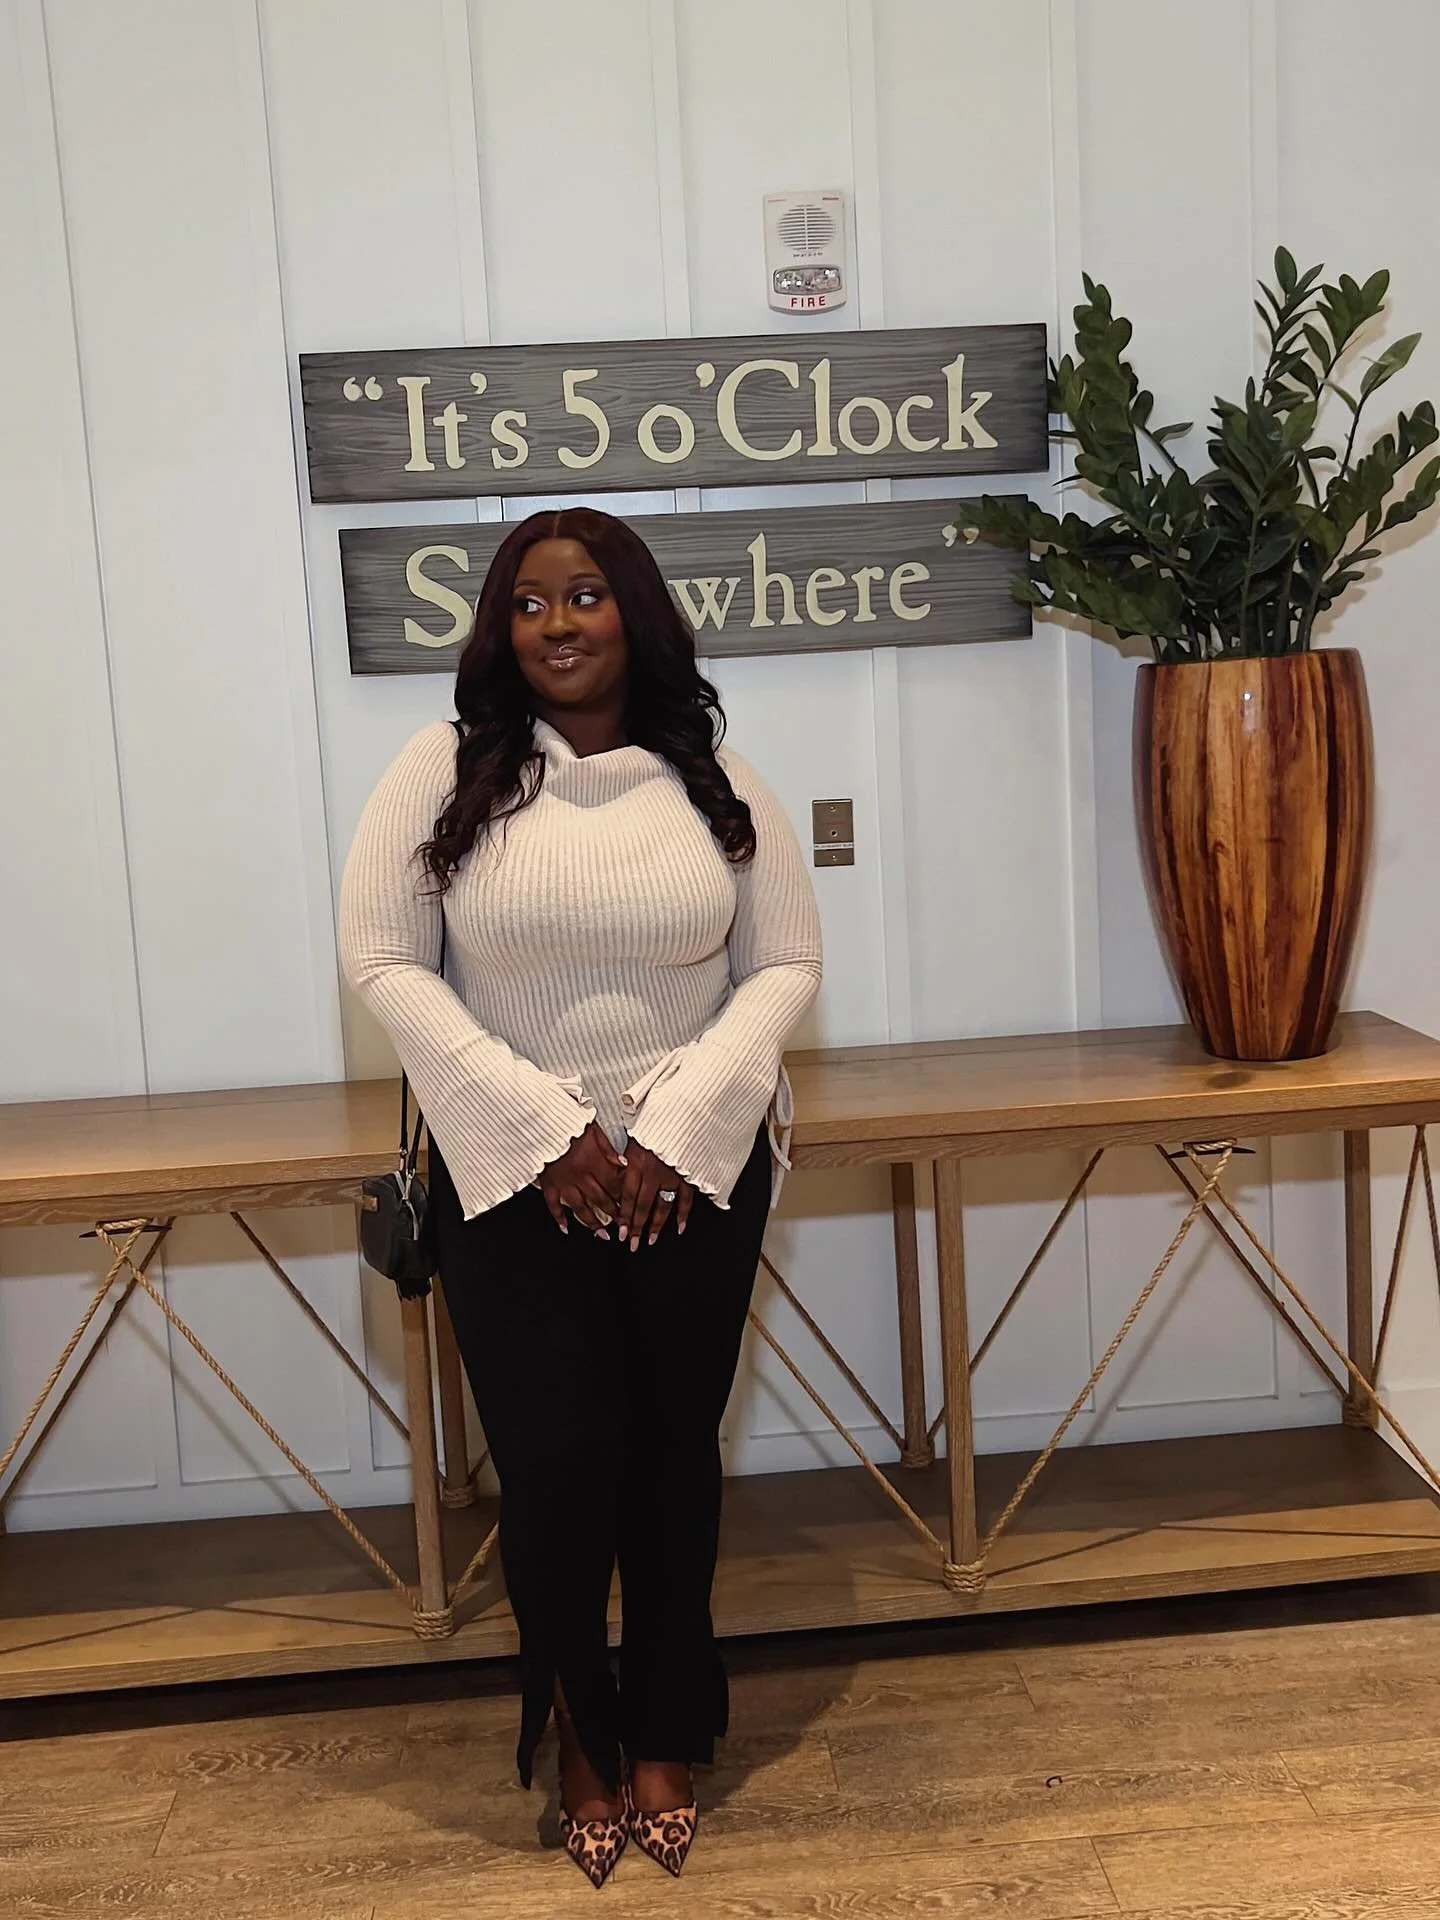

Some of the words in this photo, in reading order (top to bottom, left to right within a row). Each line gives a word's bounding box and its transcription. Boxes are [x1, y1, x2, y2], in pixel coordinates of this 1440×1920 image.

[791, 296, 826, 308] FIRE
[557, 368, 610, 469] 5
[637, 353, 999, 462] o’Clock
